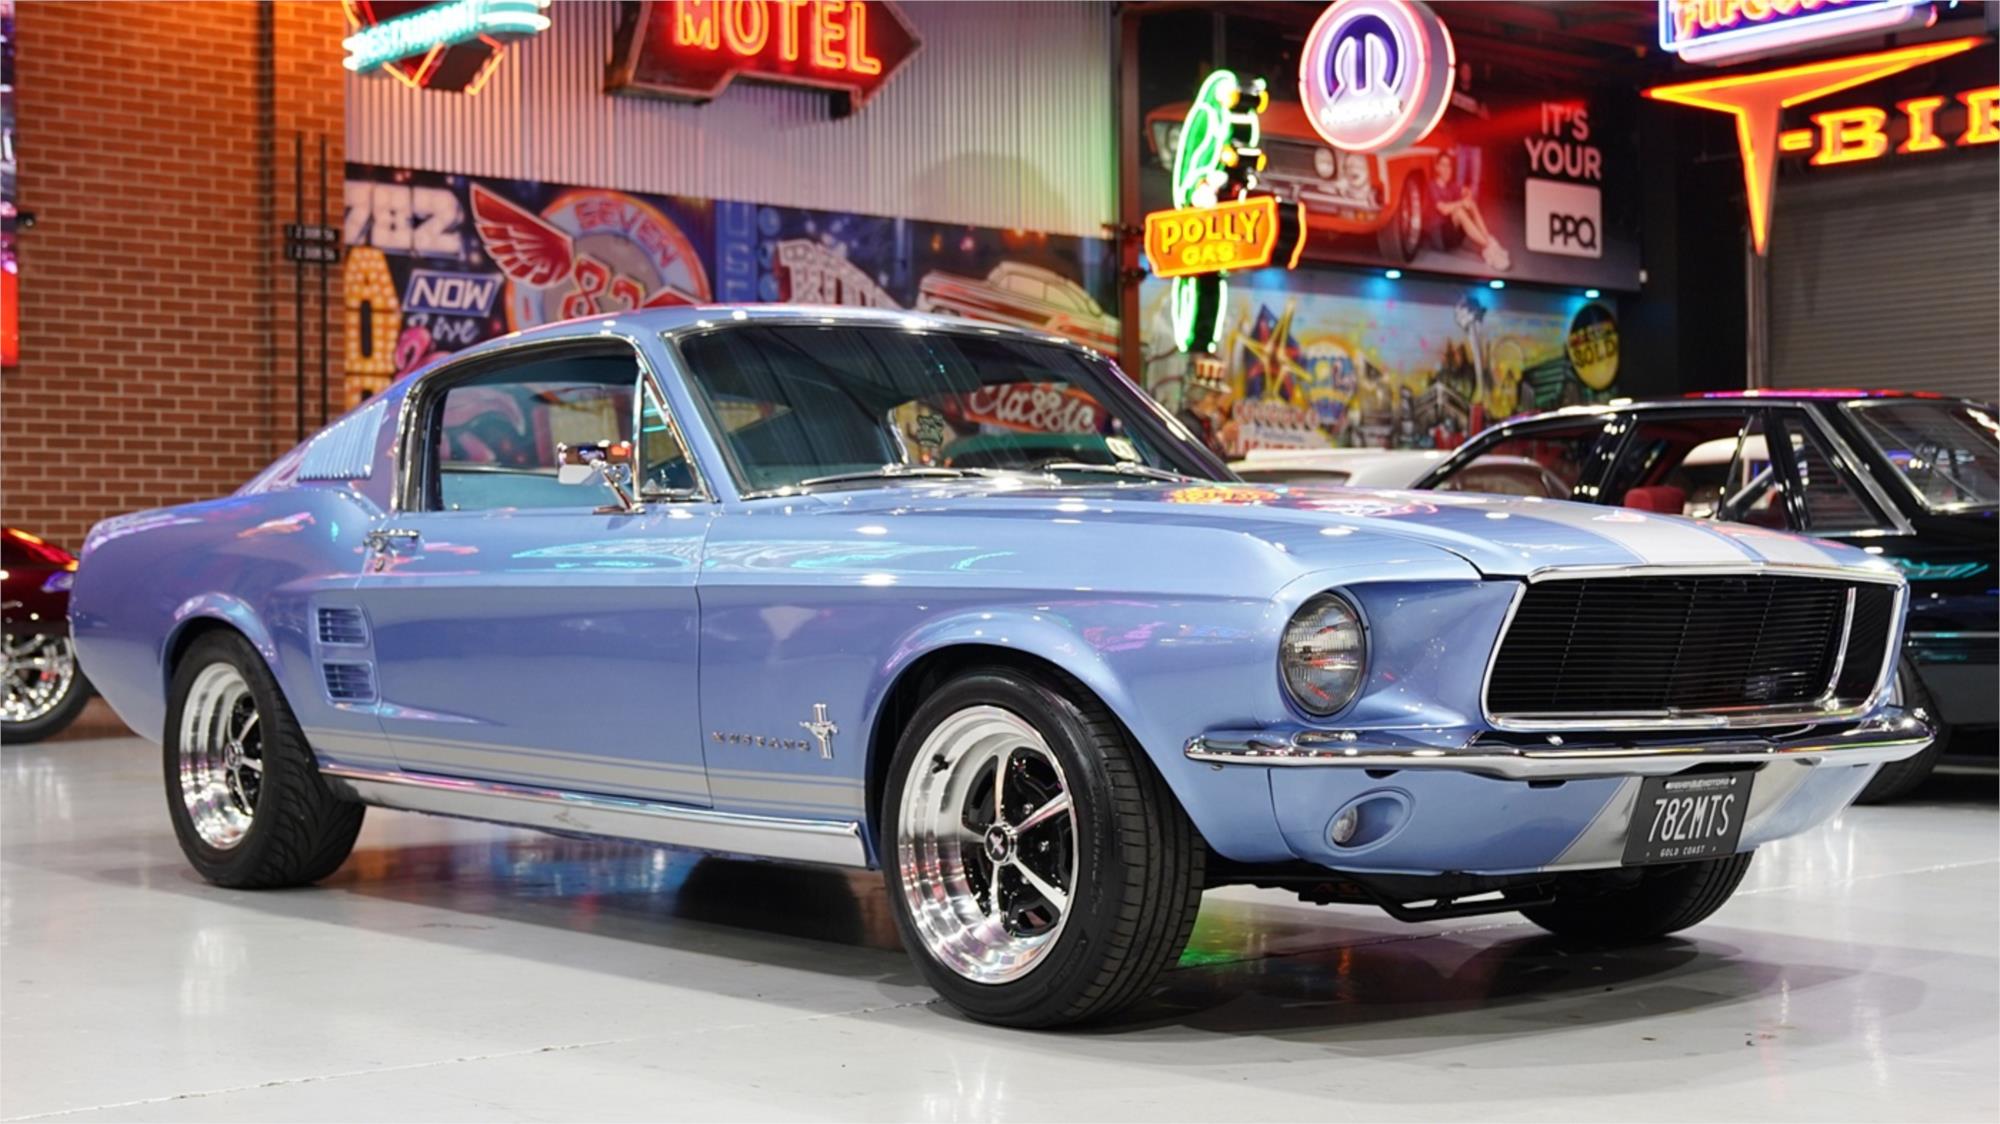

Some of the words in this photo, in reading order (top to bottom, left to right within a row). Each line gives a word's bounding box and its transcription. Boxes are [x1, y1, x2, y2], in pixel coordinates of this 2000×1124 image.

[674, 0, 882, 75] MOTEL
[1542, 101, 1589, 141] IT'S
[1524, 136, 1602, 180] YOUR
[343, 180, 464, 258] 782
[575, 199, 679, 268] SEVEN
[1159, 208, 1261, 254] POLLY
[1549, 212, 1598, 251] PPQ
[1181, 242, 1237, 267] GAS
[410, 277, 493, 316] NOW
[712, 731, 811, 751] MUSTANG
[1648, 793, 1735, 843] 782MTS
[1660, 847, 1679, 857] GOLD
[1683, 845, 1706, 856] COAST
